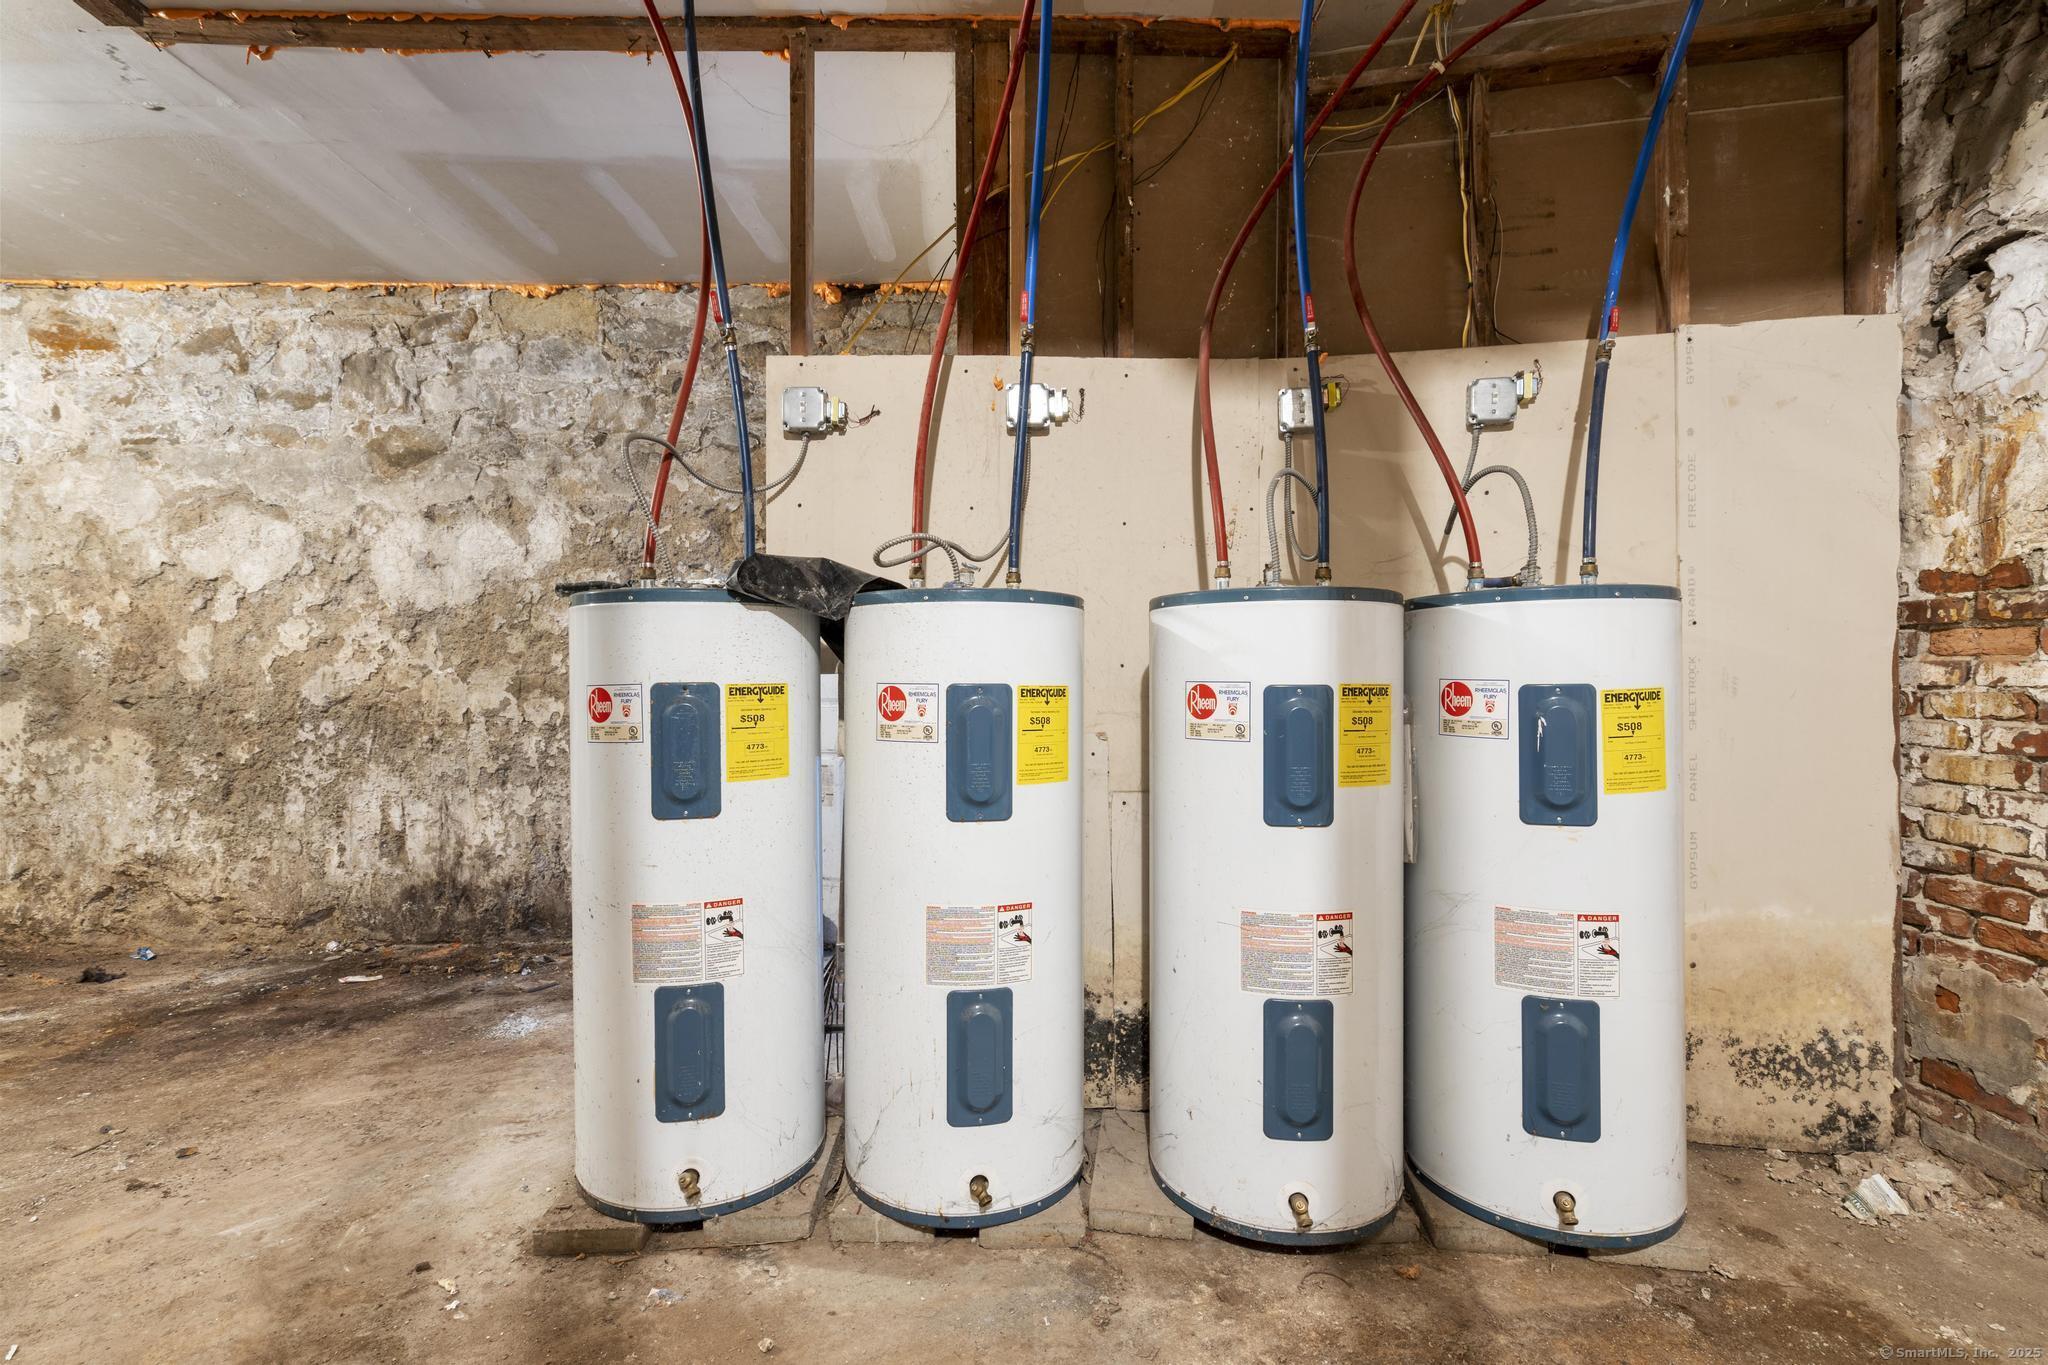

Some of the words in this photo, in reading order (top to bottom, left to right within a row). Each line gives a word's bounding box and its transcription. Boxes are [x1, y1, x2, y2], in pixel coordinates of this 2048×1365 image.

[1687, 453, 1697, 528] FIRECODE
[589, 688, 612, 718] Rheem
[729, 686, 785, 697] ENERGYGUIDE
[881, 687, 906, 717] Rheem
[1020, 688, 1066, 698] ENERGYGUIDE
[1190, 685, 1216, 715] Rheem
[1342, 687, 1389, 697] ENERGYGUIDE
[1444, 683, 1472, 712] Rheem
[1604, 691, 1661, 703] ENERGYGUIDE
[1688, 655, 1697, 731] SHEETROCK
[1688, 752, 1697, 802] PANEL
[1689, 831, 1698, 890] GYPSUM
[713, 899, 741, 907] DANGER
[1005, 903, 1031, 911] DANGER
